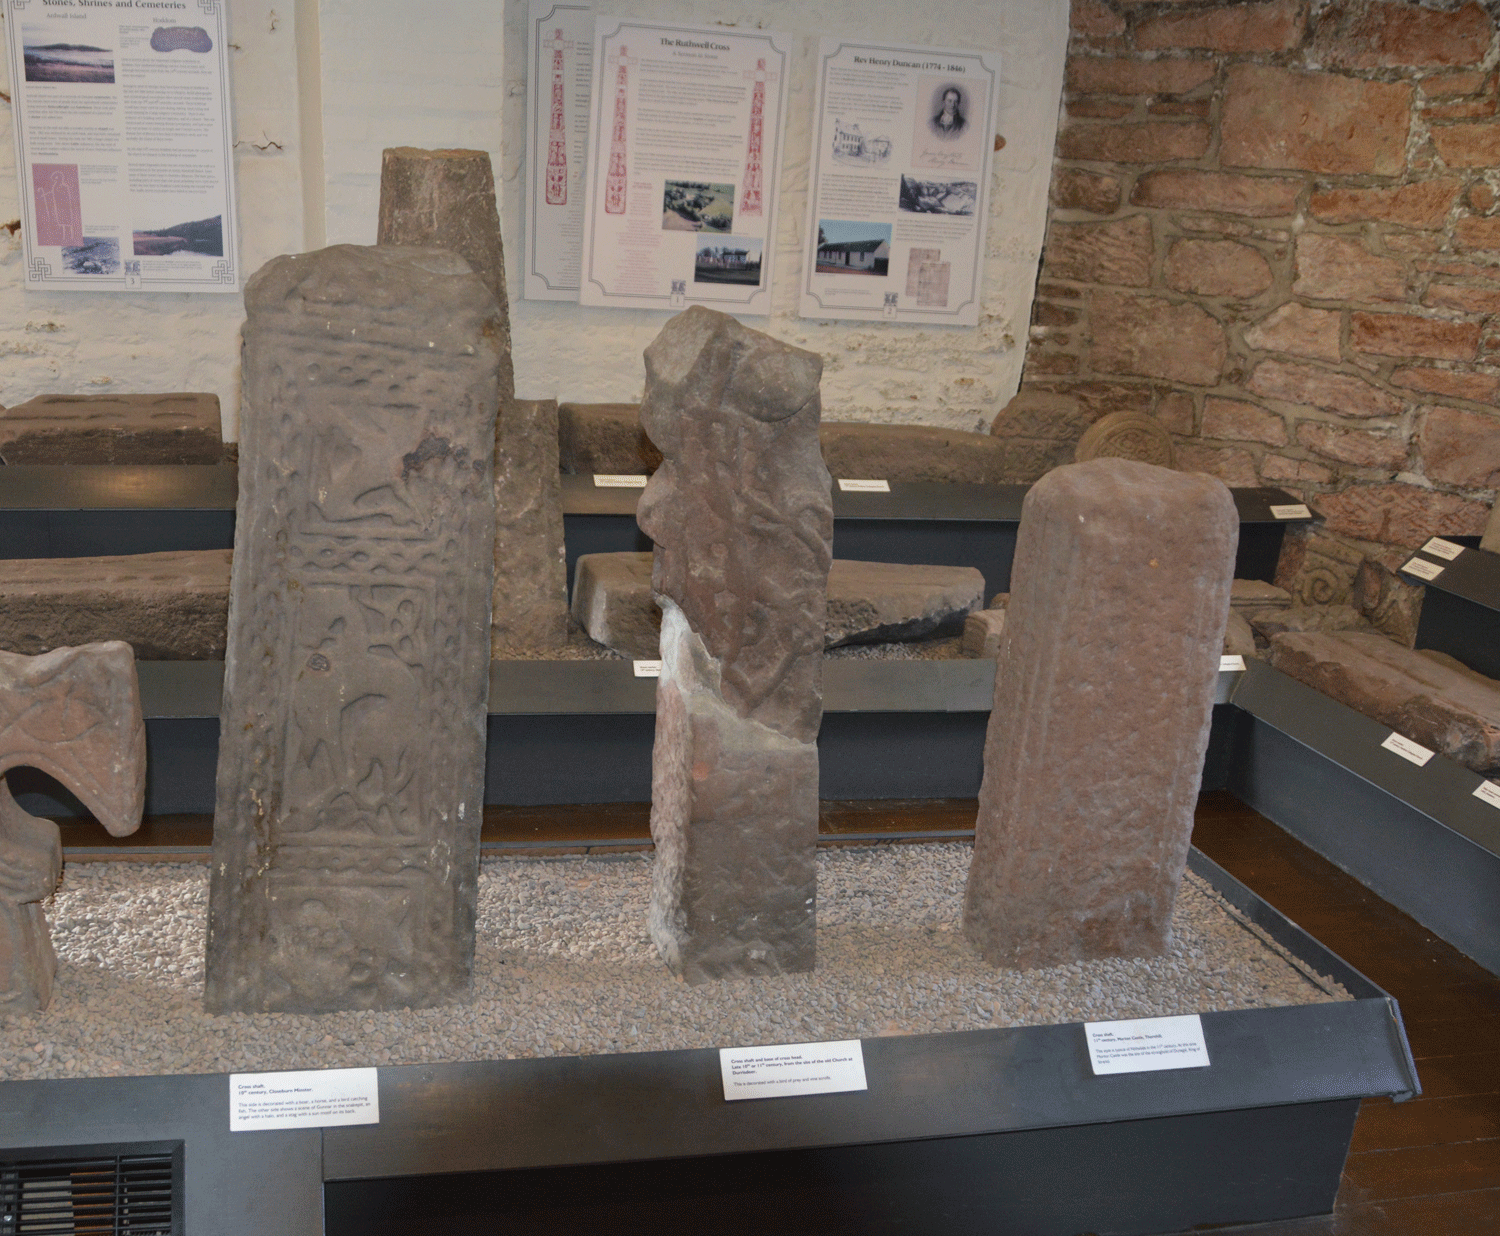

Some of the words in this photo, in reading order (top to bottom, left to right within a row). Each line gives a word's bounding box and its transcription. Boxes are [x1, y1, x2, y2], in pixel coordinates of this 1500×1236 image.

[42, 0, 75, 8] Stones,
[79, 0, 112, 8] Shrines
[116, 0, 132, 8] and
[135, 0, 186, 9] Cemeteries
[660, 38, 674, 46] The
[675, 39, 709, 50] Ruthwell
[710, 42, 730, 51] Cross
[854, 56, 867, 64] Rev
[869, 57, 891, 68] Henry
[892, 59, 921, 69] Duncan
[922, 61, 941, 71] (1774
[947, 63, 966, 73] 1846)
[130, 277, 136, 285] 3
